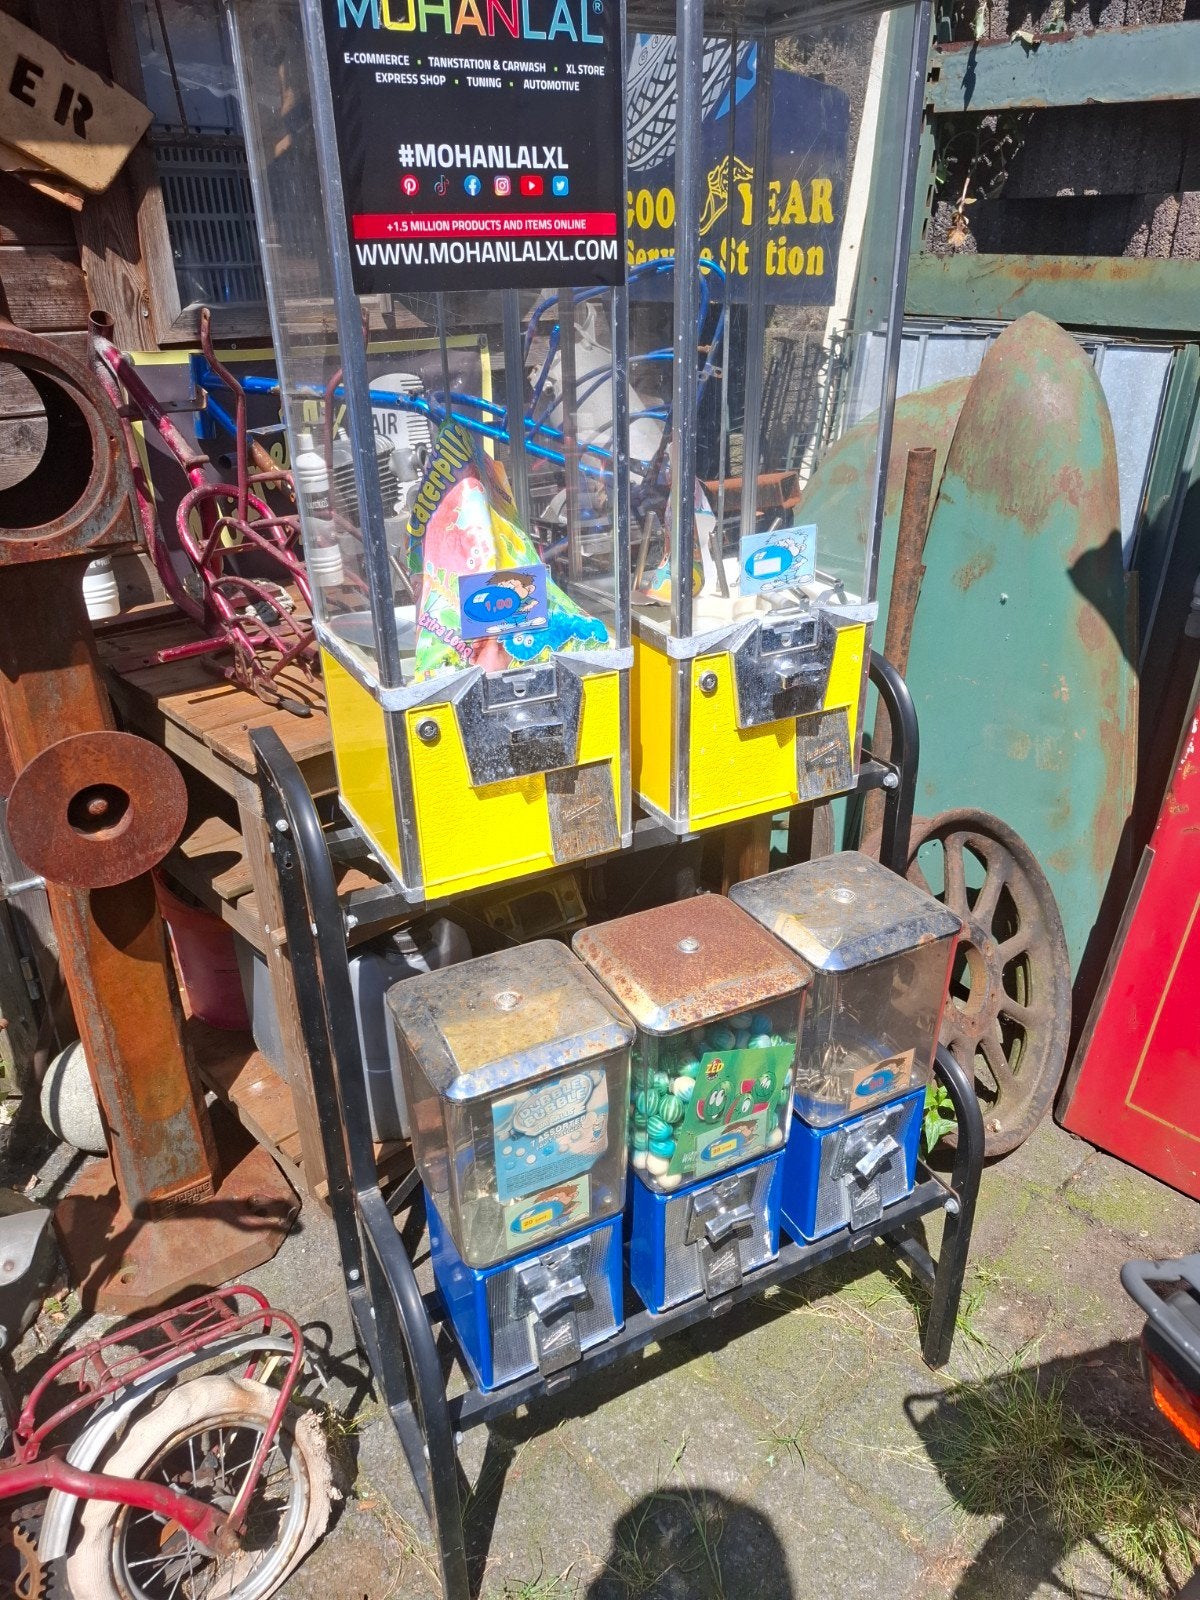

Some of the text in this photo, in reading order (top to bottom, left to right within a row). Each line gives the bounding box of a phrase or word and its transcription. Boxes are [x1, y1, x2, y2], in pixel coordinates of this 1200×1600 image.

[343, 52, 605, 76] E-COMMERCE TANKSTATION & CARWASH XL STORE
[375, 72, 580, 92] EXPRESS SHOP TUNING AUTOMOTIVE
[398, 143, 569, 169] #MOHANLALXL
[386, 218, 587, 232] +1.5 MILLION PRODUCTS AND ITEMS ONLINE
[355, 239, 618, 266] WWW.MOHANLALXL.COM
[720, 235, 824, 276] Sttion
